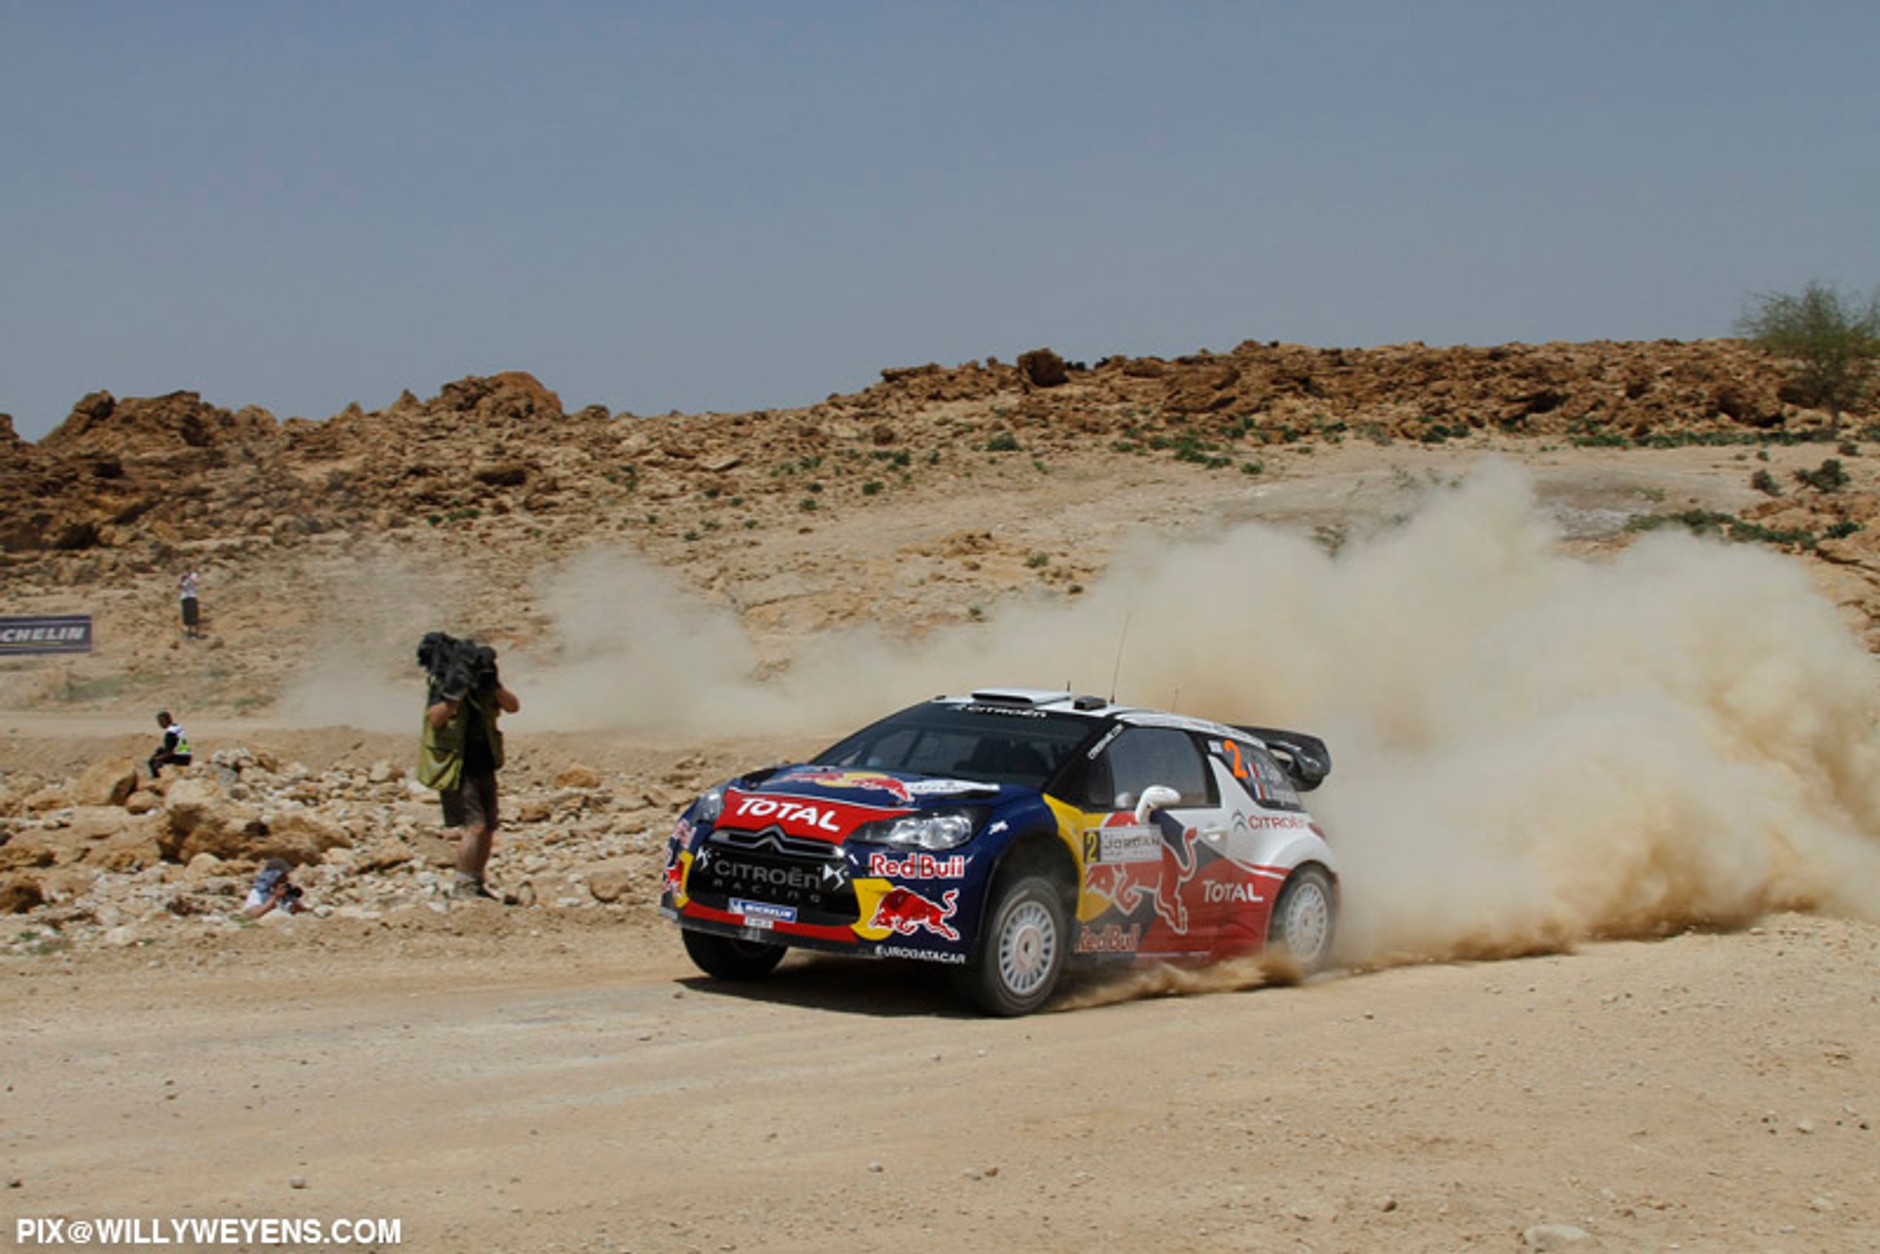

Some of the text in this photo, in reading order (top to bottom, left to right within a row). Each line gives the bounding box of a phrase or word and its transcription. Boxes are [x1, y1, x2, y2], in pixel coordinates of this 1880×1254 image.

[1, 627, 85, 642] CHELIN
[1223, 739, 1249, 779] 2
[736, 797, 841, 833] TOTAL
[1087, 832, 1098, 863] 2
[869, 853, 965, 879] Red Bull
[1202, 879, 1264, 903] TOTAL
